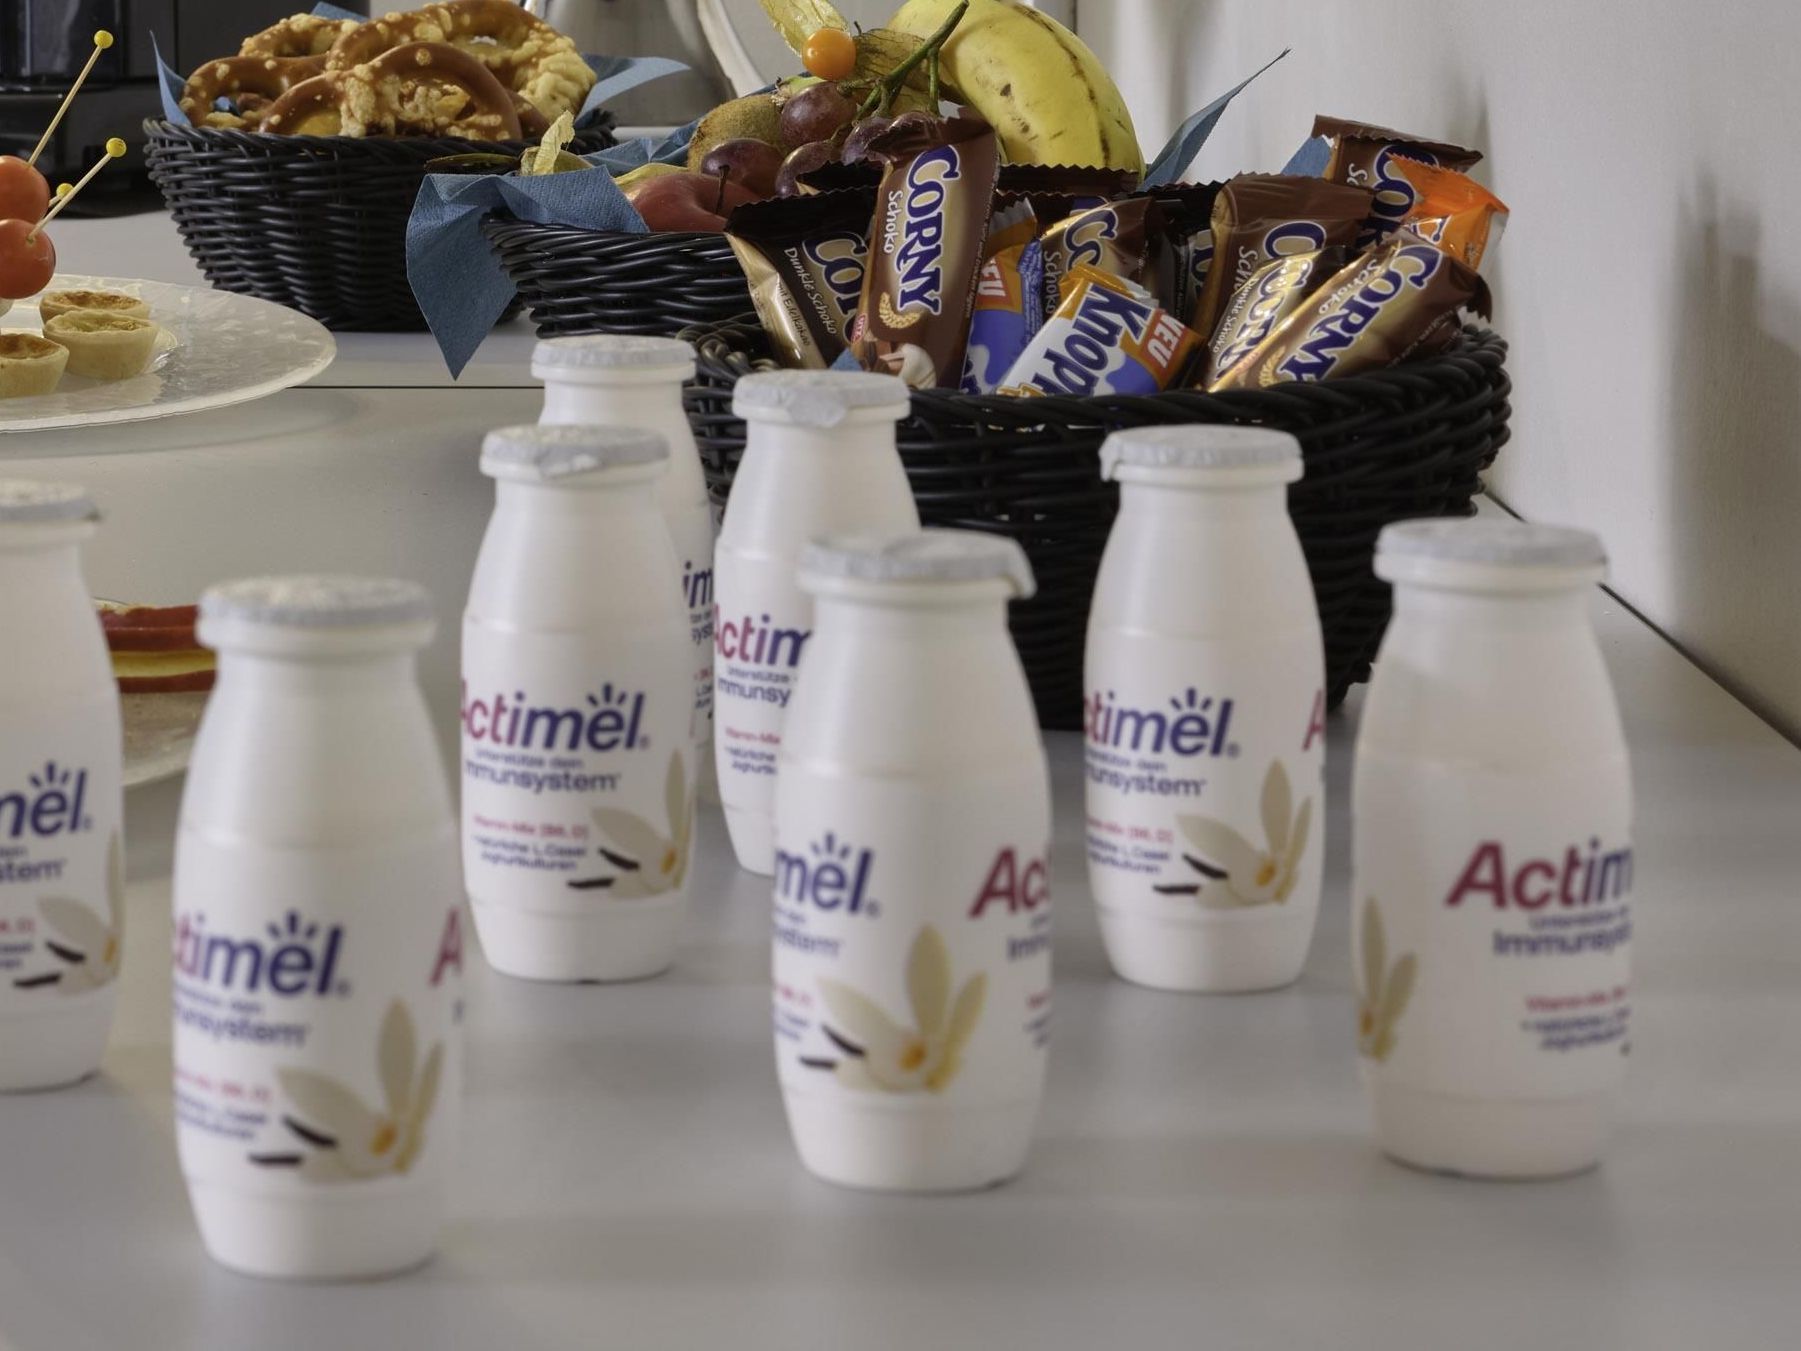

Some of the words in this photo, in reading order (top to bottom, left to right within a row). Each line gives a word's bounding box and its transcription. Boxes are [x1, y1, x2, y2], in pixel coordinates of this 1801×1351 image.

[883, 189, 904, 254] Schoko
[896, 144, 960, 316] CORNY
[784, 247, 815, 292] Dunkle
[807, 292, 838, 336] Schoko
[977, 256, 1007, 298] EU
[1043, 250, 1062, 315] Schoko
[1318, 258, 1381, 315] Schoko
[1148, 313, 1186, 369] NEU
[1212, 315, 1238, 354] Schoko
